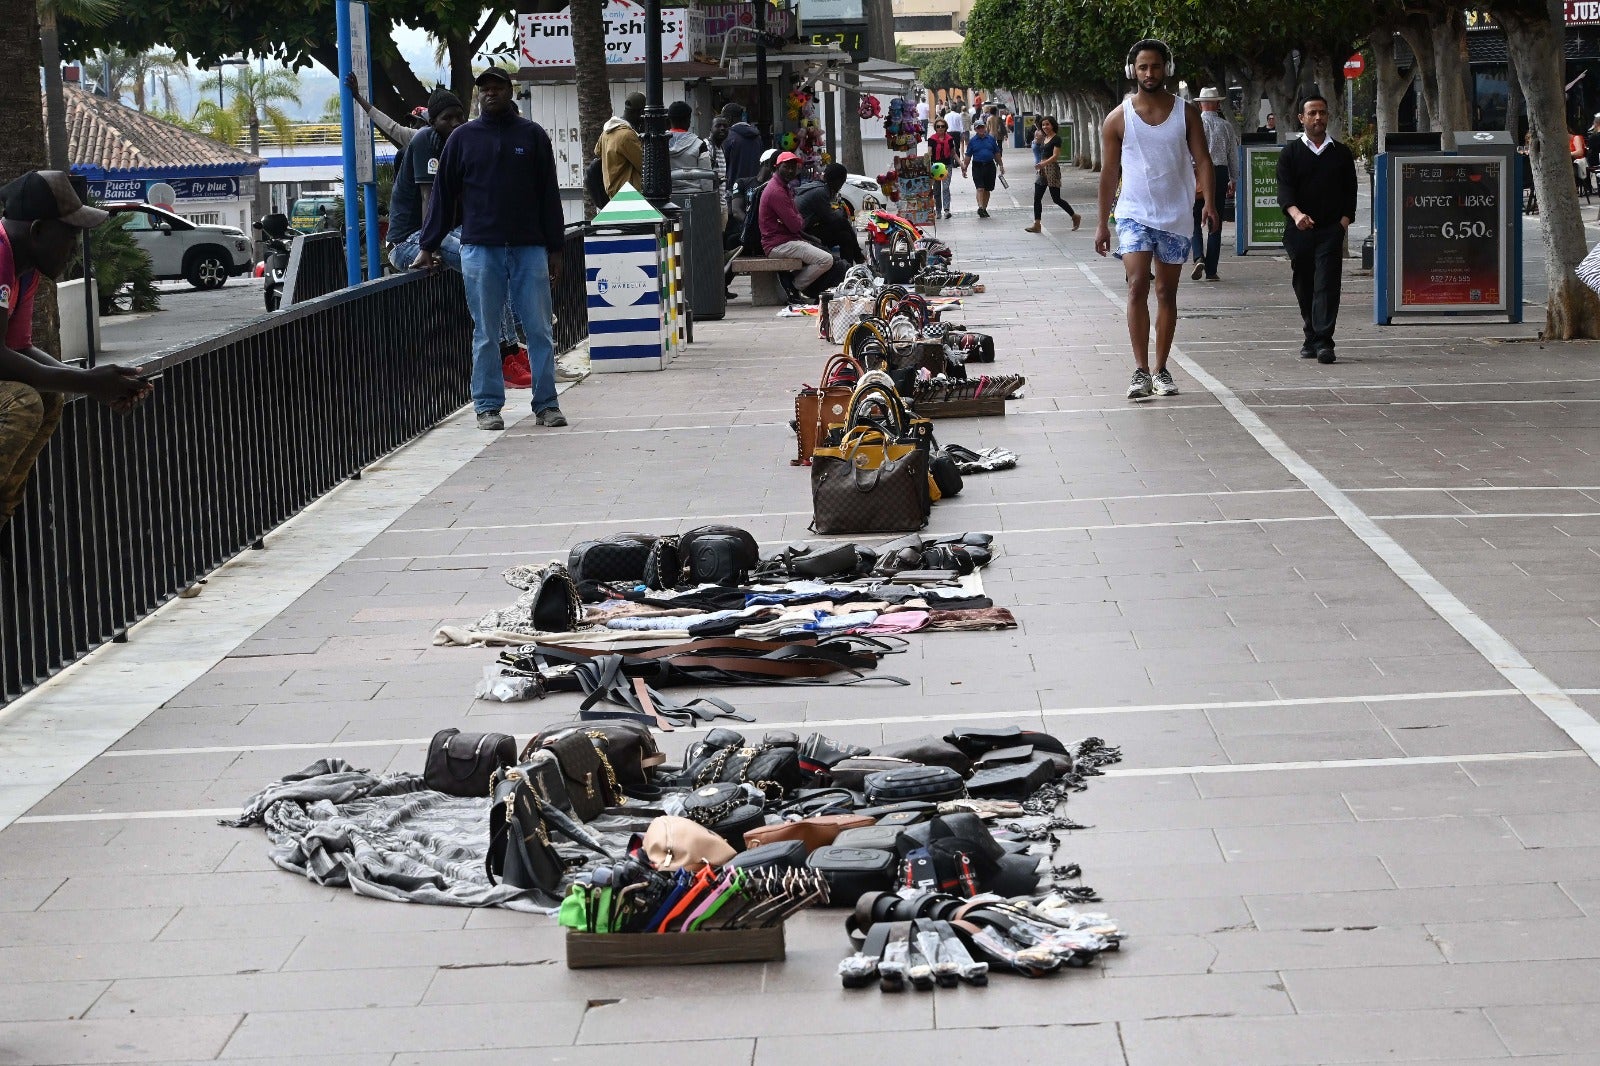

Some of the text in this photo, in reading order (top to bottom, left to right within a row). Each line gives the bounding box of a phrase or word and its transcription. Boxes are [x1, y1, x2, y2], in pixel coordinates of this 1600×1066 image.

[1571, 2, 1600, 20] JUE
[604, 19, 676, 35] T-shits
[105, 181, 141, 190] Puerto
[191, 182, 203, 193] fly
[206, 181, 227, 191] blue
[104, 189, 137, 198] Banús
[1406, 195, 1495, 207] BUFFET LIBRE
